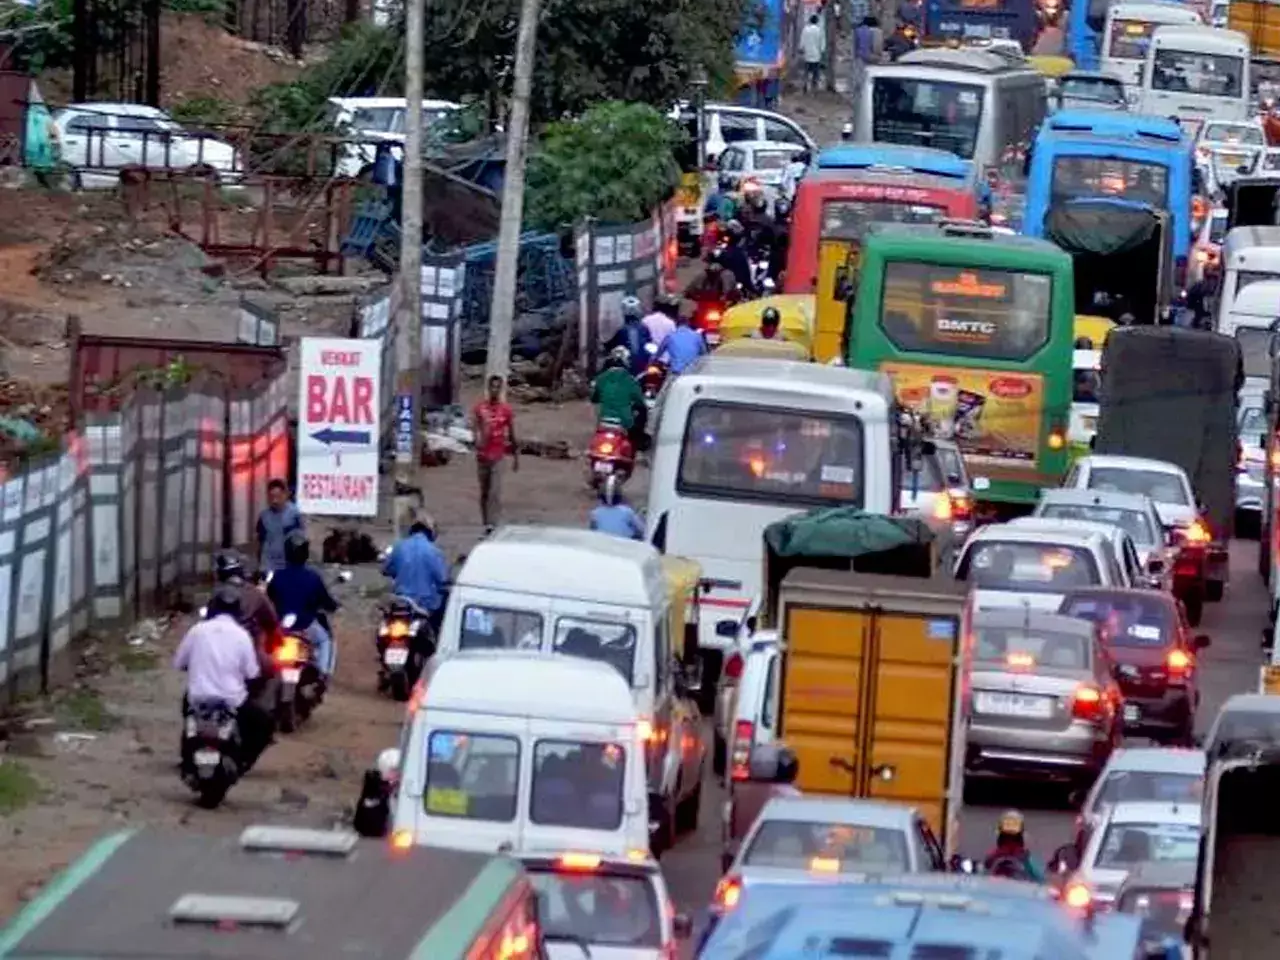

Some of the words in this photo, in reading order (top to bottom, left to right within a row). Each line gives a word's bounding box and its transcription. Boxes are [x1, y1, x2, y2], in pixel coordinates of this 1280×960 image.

[937, 319, 997, 333] BMTC
[307, 375, 374, 424] BAR
[302, 473, 374, 501] RESTAURANT
